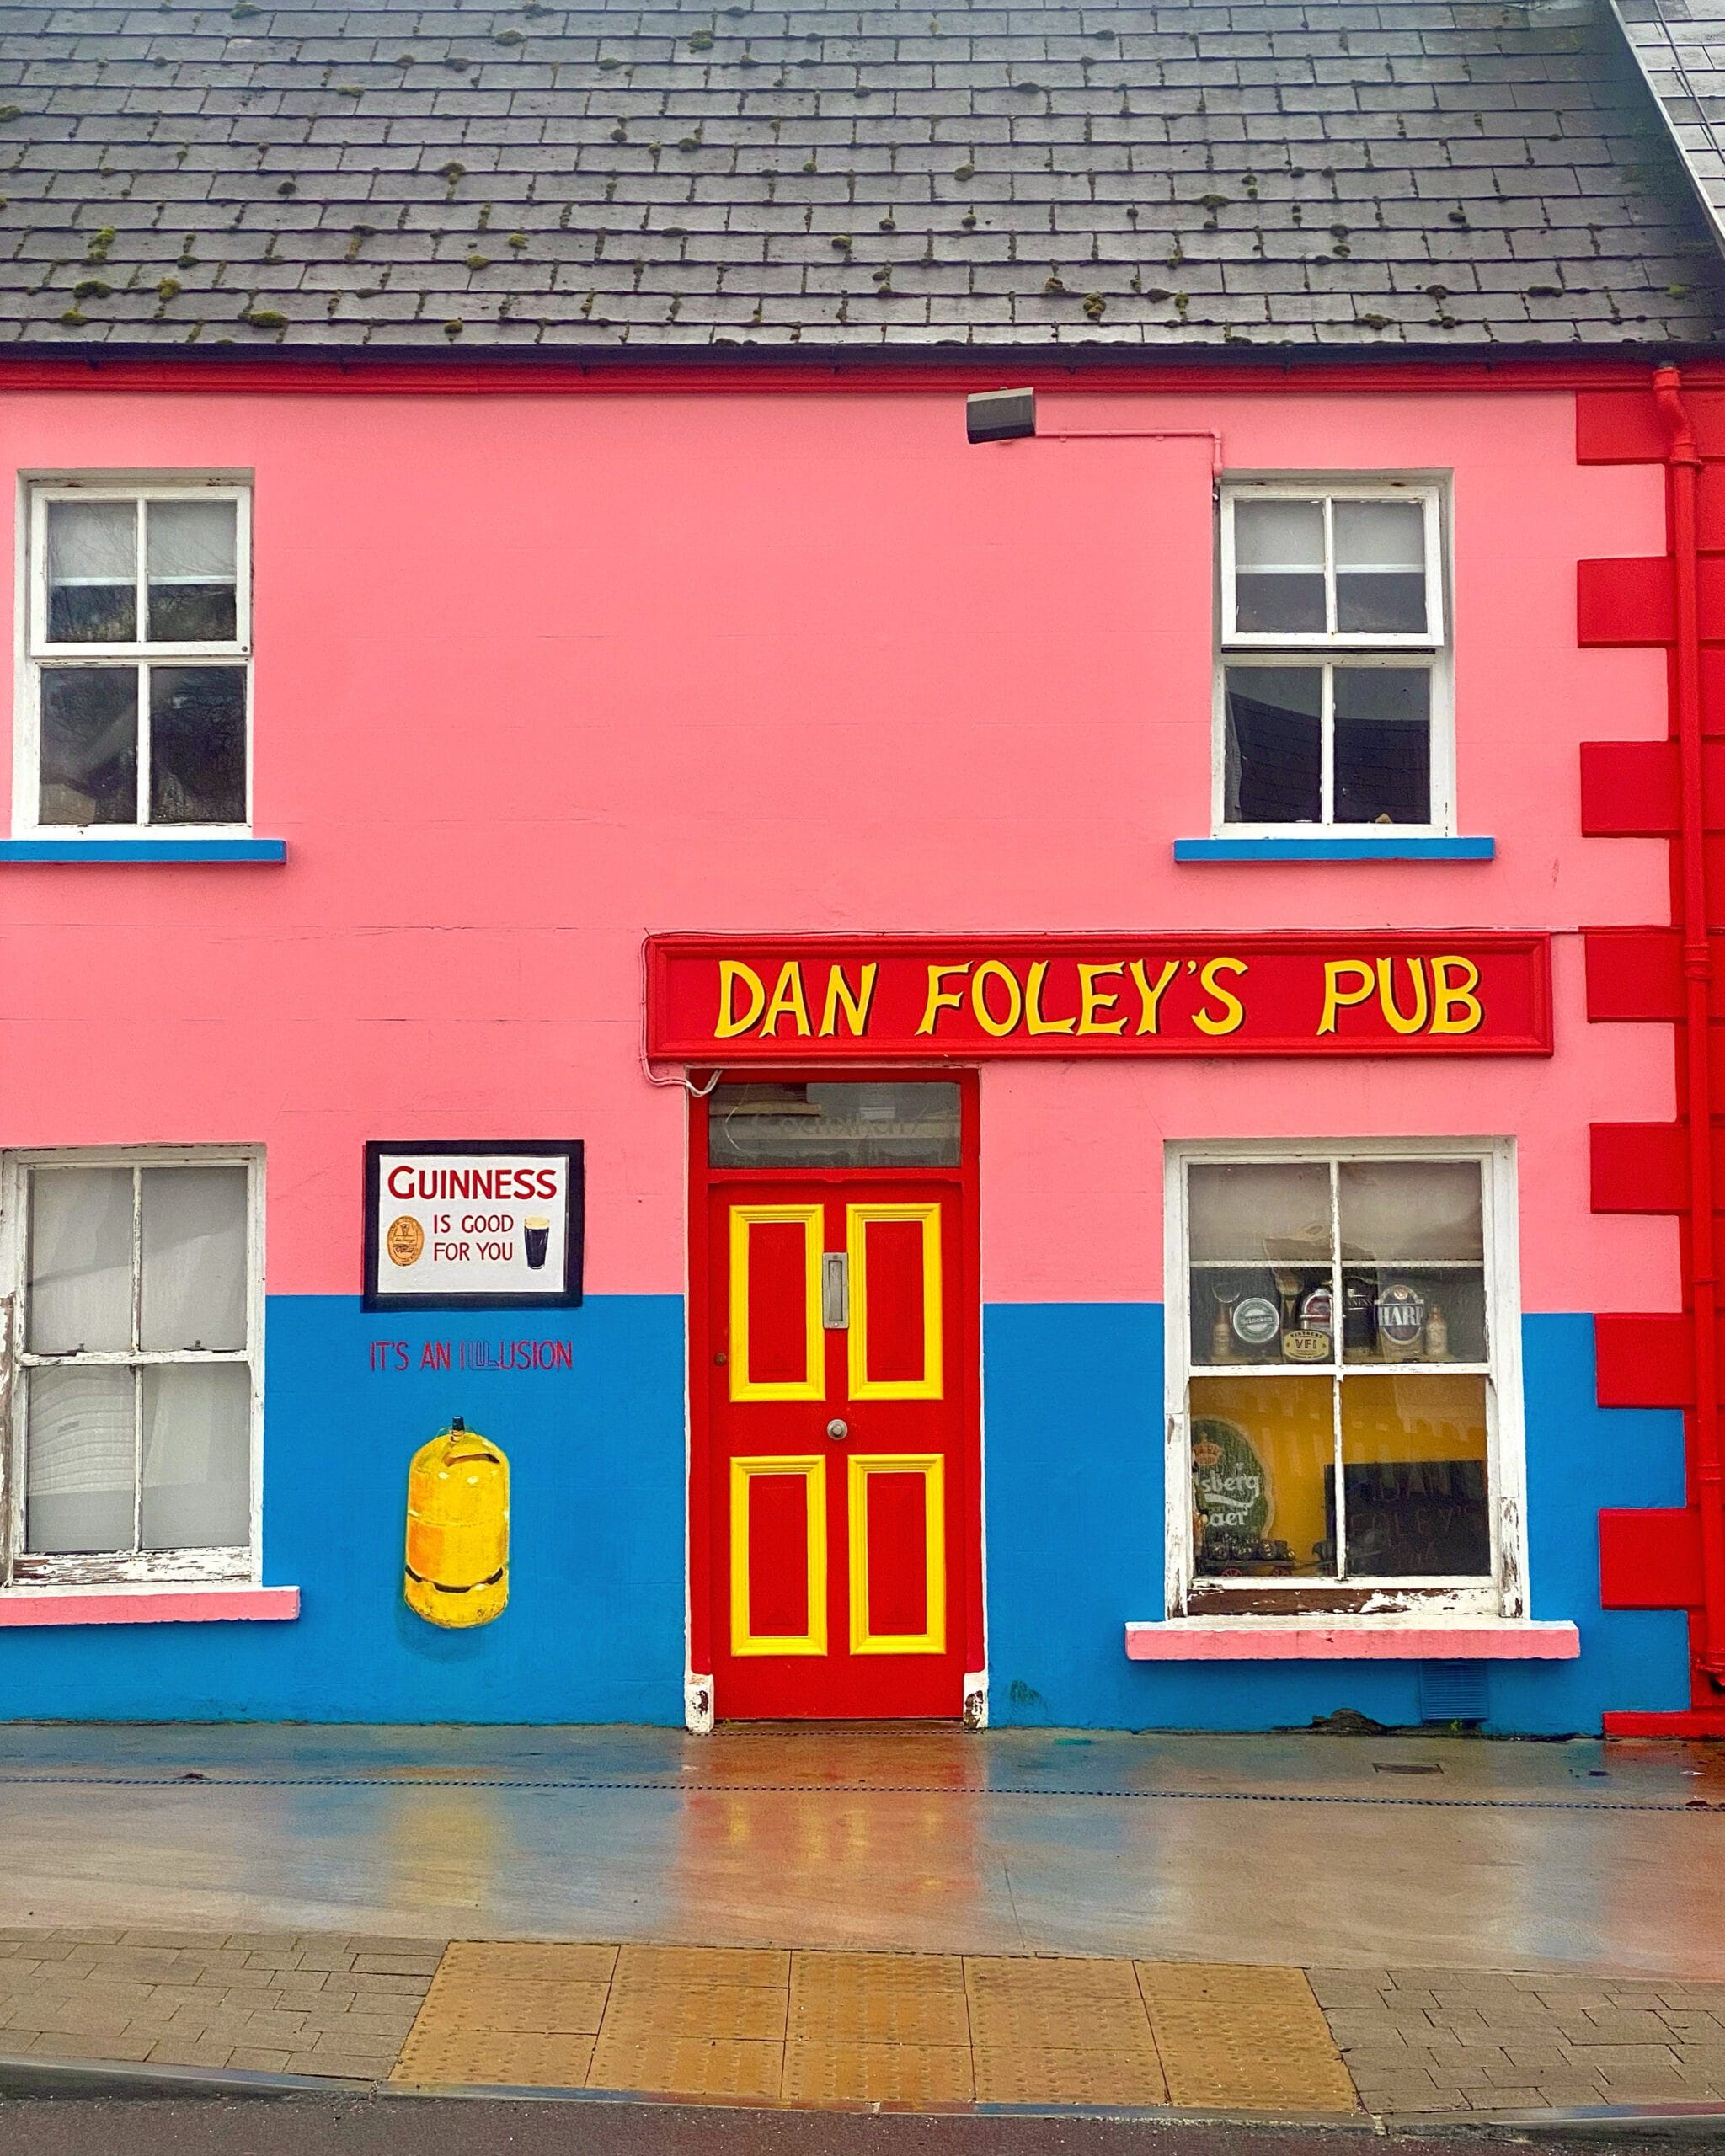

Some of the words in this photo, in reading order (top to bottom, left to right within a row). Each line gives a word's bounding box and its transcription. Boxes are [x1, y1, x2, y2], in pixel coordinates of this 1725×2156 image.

[714, 960, 879, 1038] DAN
[915, 957, 1249, 1036] FOLEY'S
[1316, 955, 1483, 1036] PUB
[388, 1166, 557, 1199] GUINNESS
[434, 1214, 451, 1234] IS
[461, 1214, 514, 1234] GOOD
[434, 1242, 470, 1261] FOR
[477, 1242, 513, 1261] YOU
[1378, 1306, 1423, 1326] HARP
[1295, 1339, 1316, 1348] VFI
[371, 1341, 409, 1371] IT'S
[419, 1341, 451, 1371] AN
